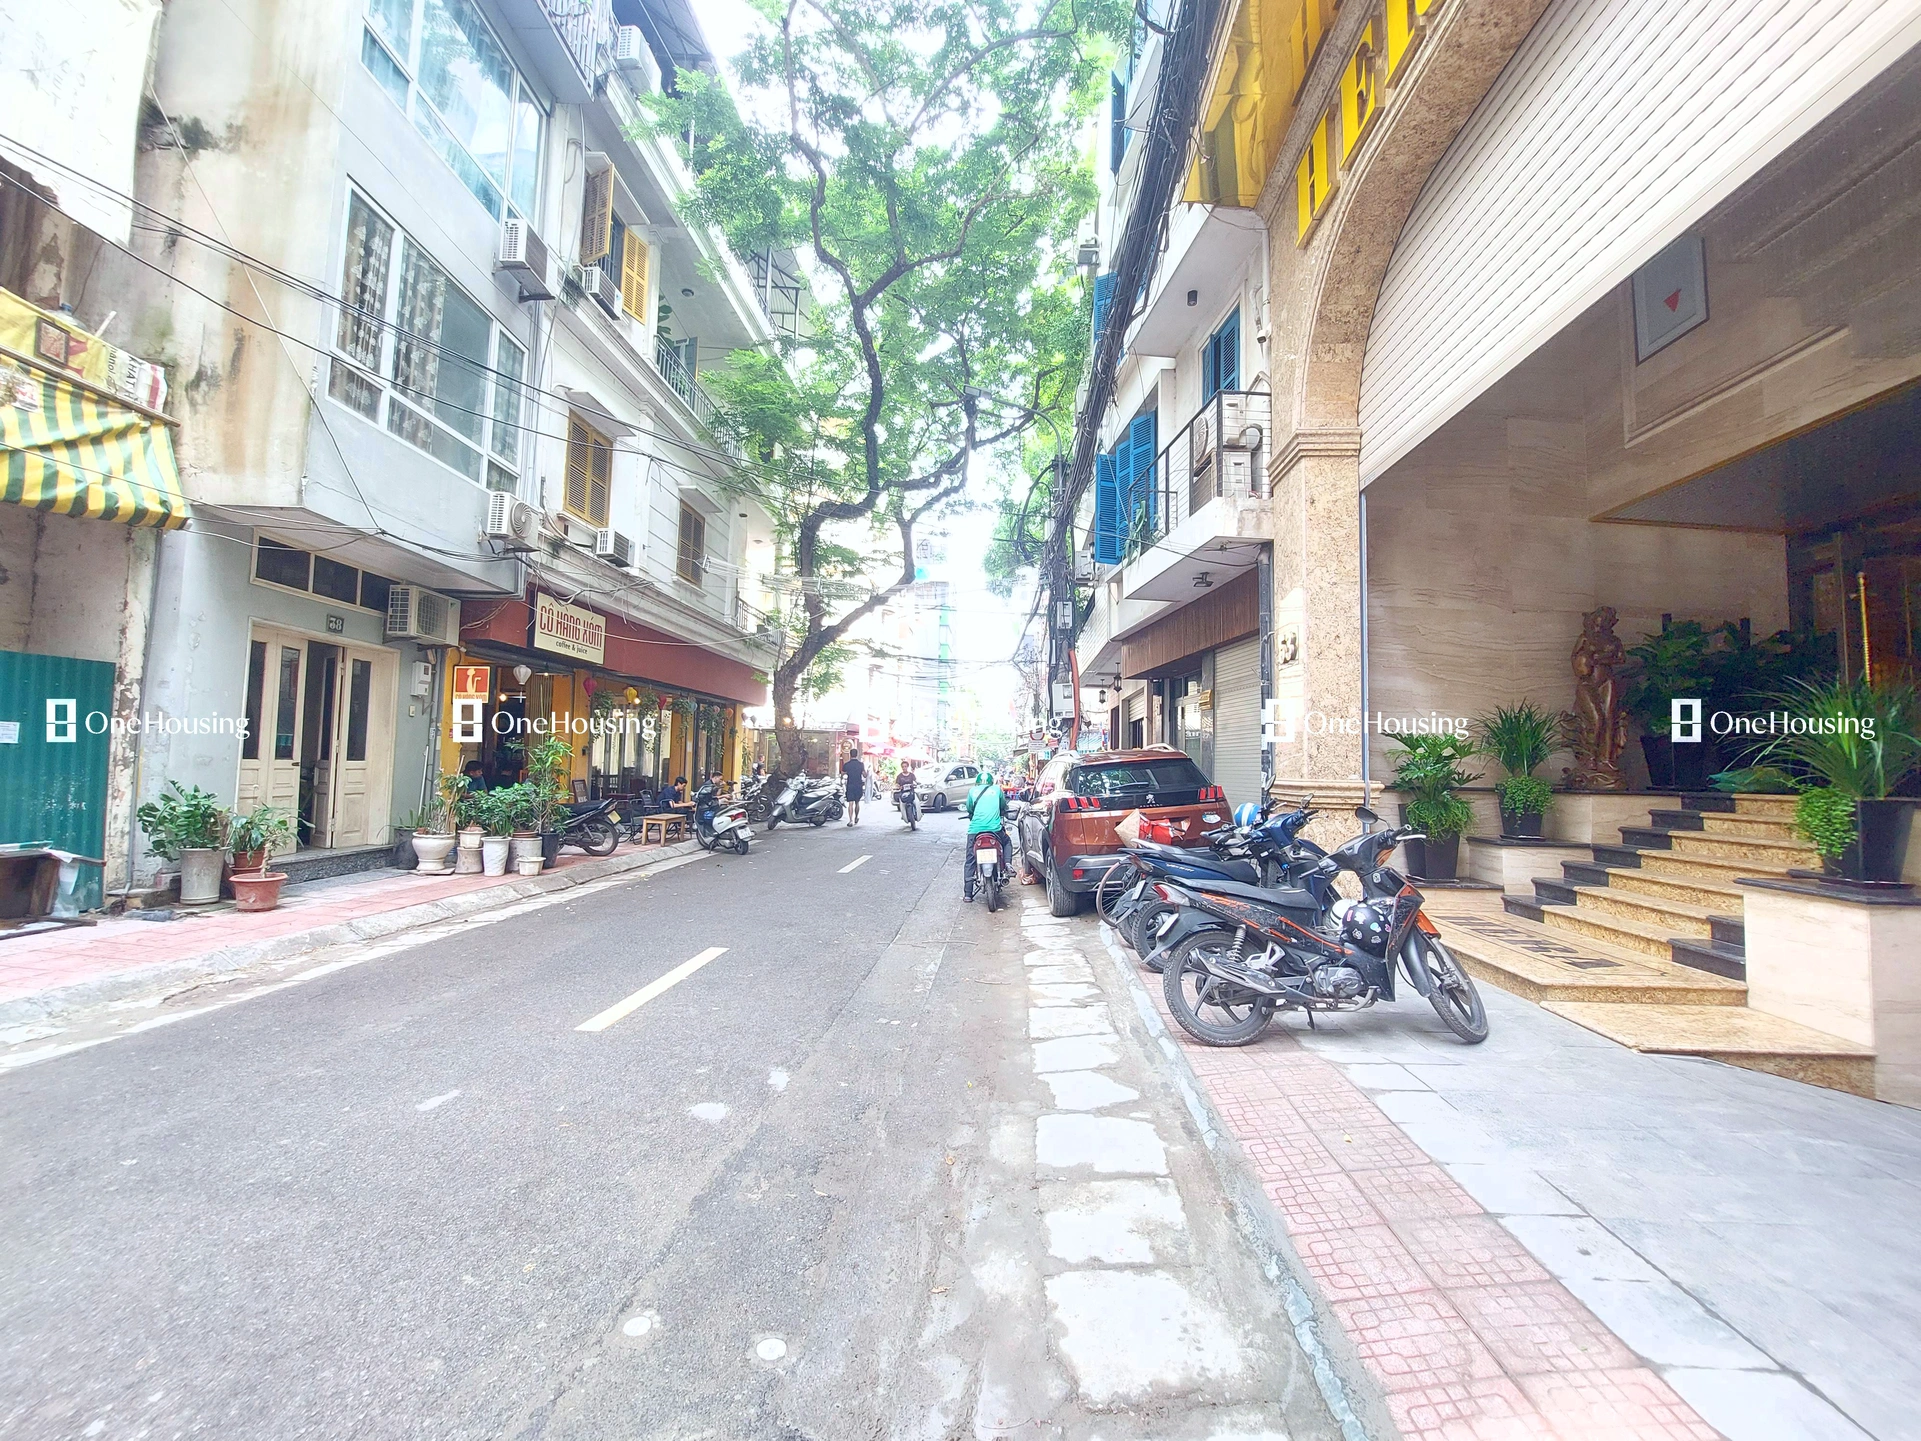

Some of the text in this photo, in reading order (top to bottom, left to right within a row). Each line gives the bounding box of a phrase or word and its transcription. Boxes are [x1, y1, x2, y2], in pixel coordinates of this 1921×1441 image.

[329, 617, 343, 631] 38
[539, 602, 554, 633] CÔ
[555, 640, 588, 655] coffee & juice
